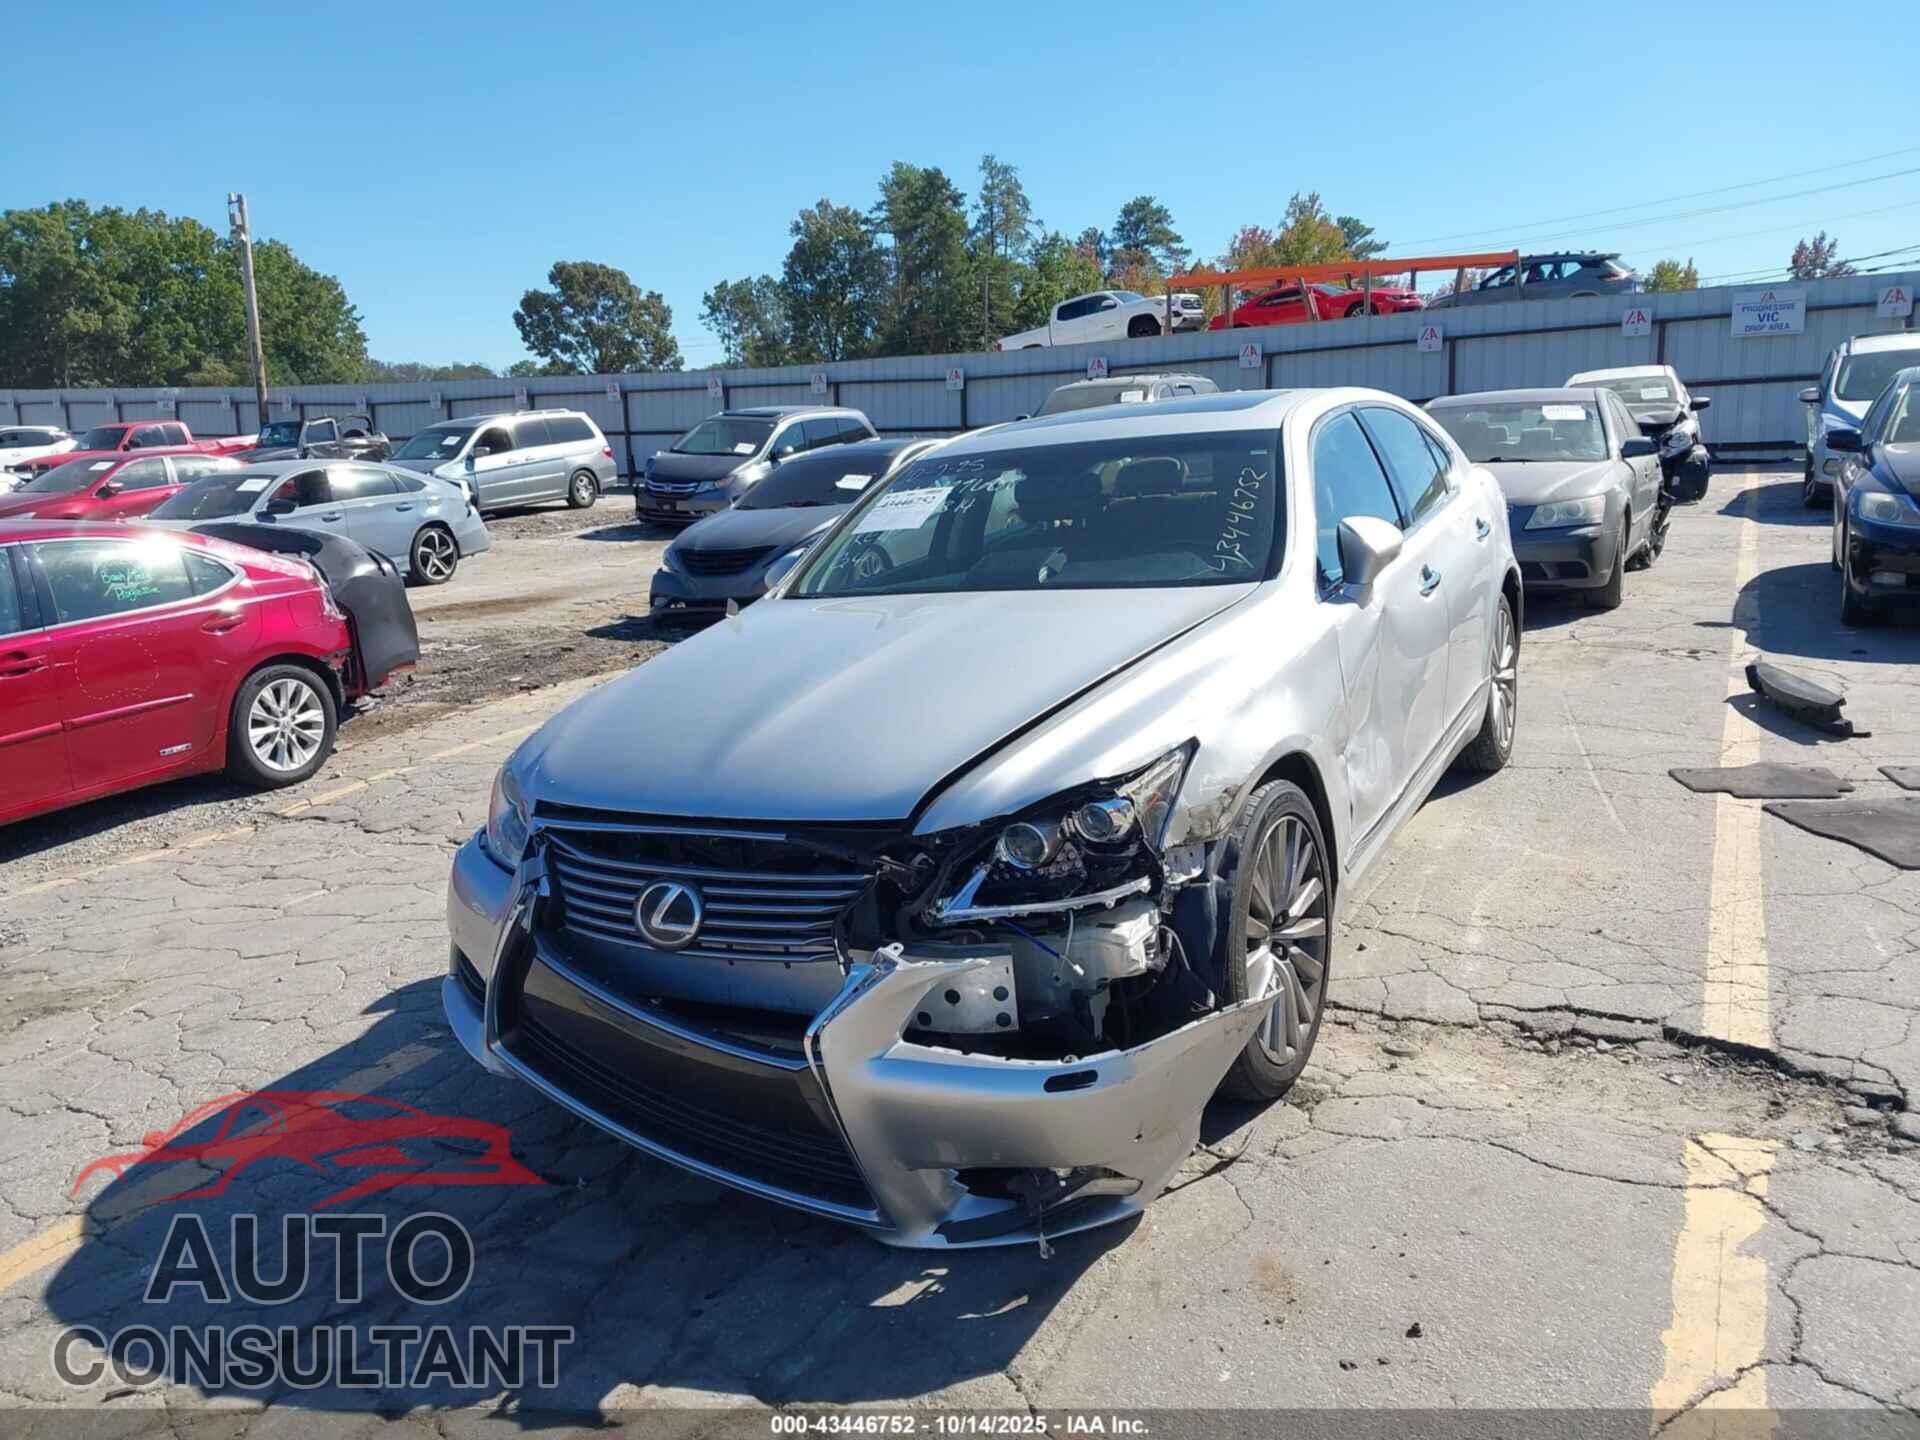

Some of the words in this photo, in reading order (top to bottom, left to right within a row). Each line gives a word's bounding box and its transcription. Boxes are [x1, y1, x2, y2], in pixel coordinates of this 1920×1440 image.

[1757, 312, 1780, 322] VIC
[1768, 322, 1791, 331] AREA
[1208, 467, 1268, 572] 43446752
